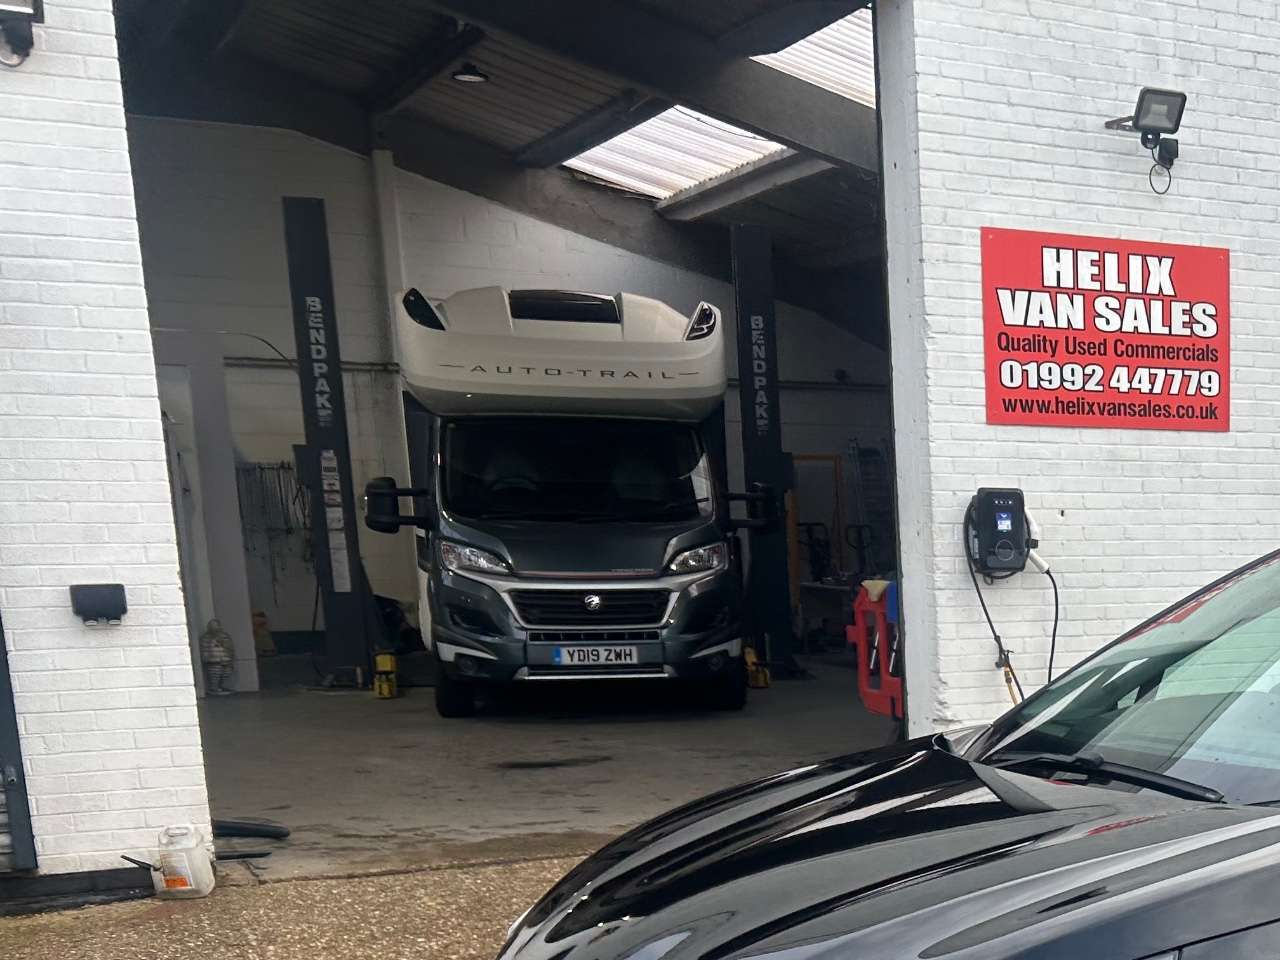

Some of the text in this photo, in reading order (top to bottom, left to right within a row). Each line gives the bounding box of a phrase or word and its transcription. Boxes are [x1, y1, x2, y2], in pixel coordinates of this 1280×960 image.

[1041, 245, 1177, 297] HELIX
[996, 288, 1219, 338] VAN SALES
[305, 296, 332, 409] BENDPAK
[997, 332, 1219, 362] Quality Used Commercials
[471, 365, 675, 379] AUTO-TRAIL
[750, 315, 769, 418] BENDPAK
[1000, 359, 1220, 397] 01992 447779
[1002, 396, 1219, 420] www.helixvansales.co.uk
[567, 648, 633, 662] YD19 ZWH
